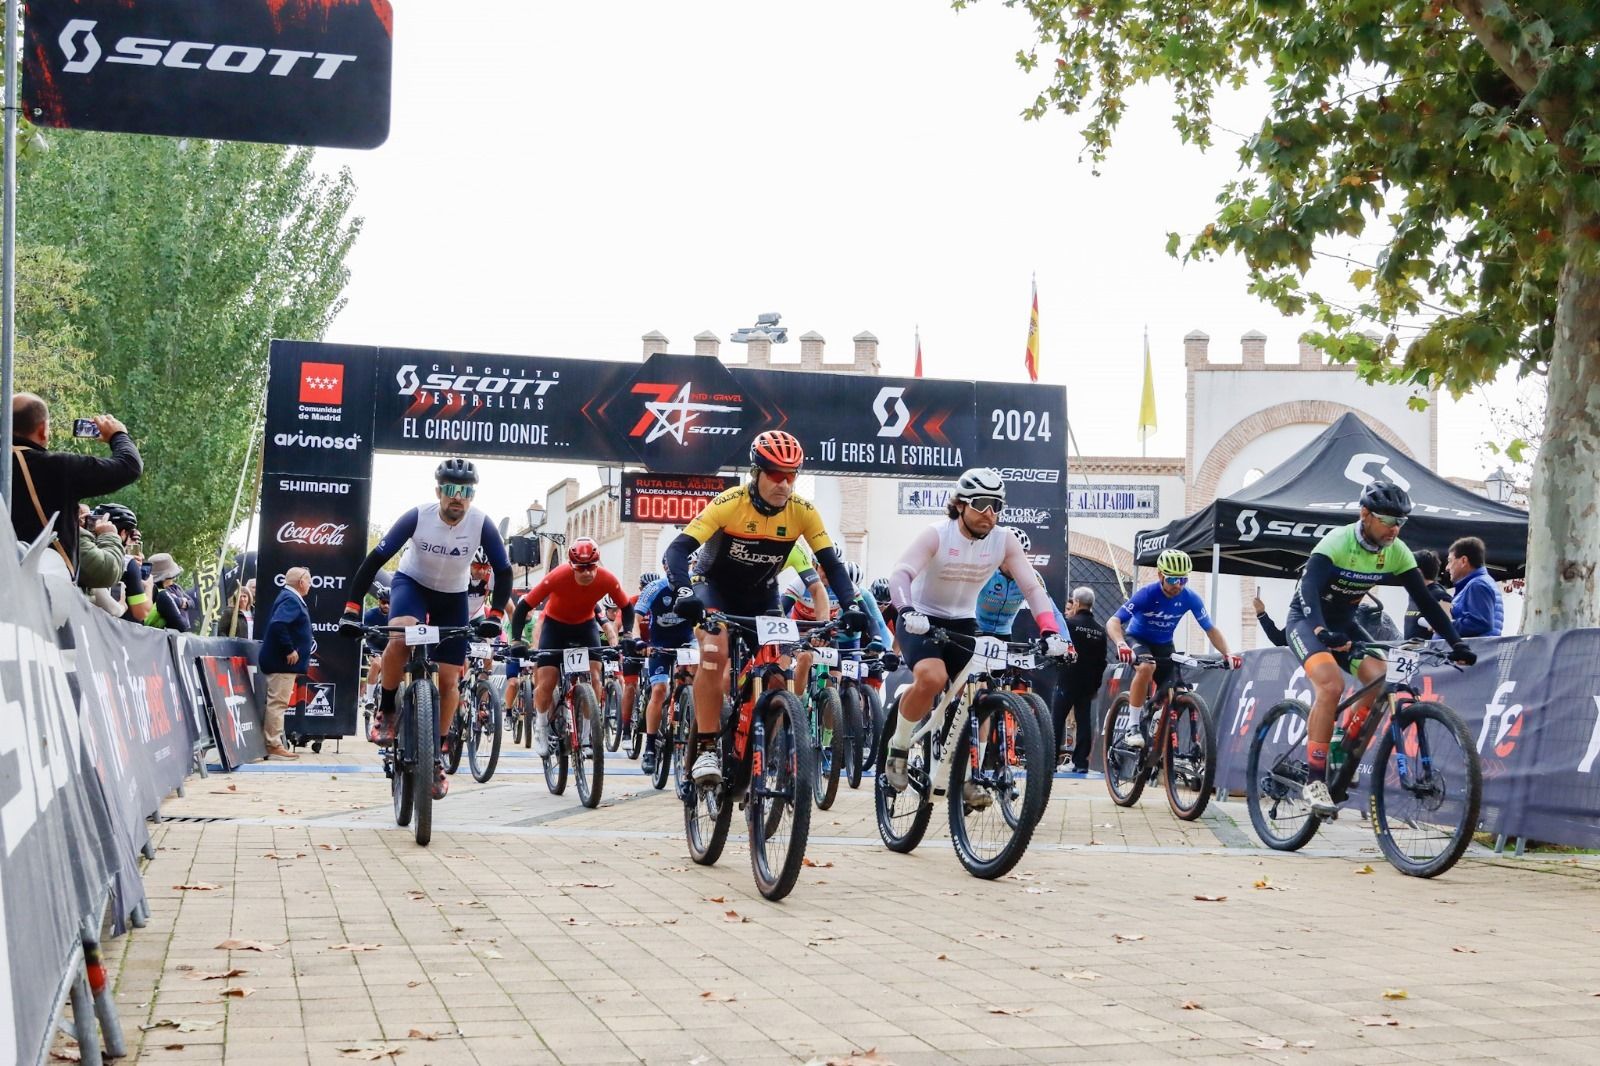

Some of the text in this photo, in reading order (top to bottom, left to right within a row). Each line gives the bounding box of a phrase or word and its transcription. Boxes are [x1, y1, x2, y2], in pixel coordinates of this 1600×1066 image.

[105, 36, 357, 80] SCOTT
[432, 364, 560, 379] CIRCUITO
[421, 374, 560, 396] SCOTT
[298, 405, 342, 414] Comunidad
[298, 412, 341, 421] de Madrid
[403, 417, 419, 438] EL
[425, 418, 493, 442] CIRCUITO
[500, 423, 549, 445] DONDE
[688, 426, 742, 435] SCOTT
[992, 409, 1051, 442] 2024
[274, 429, 358, 450] avimosa
[820, 438, 836, 461] TÚ
[841, 442, 875, 464] ERES
[880, 443, 896, 465] LA
[902, 445, 963, 468] ESTRELLA
[280, 480, 350, 494] SHIMANO
[636, 479, 664, 488] RUTA
[665, 480, 685, 489] DEL
[636, 487, 722, 497] VALDEOLMOS-ALALPARD
[922, 490, 952, 508] PLAZ
[1077, 492, 1135, 510] ALALPARDO
[998, 508, 1038, 518] CTORY
[276, 521, 349, 546] Coca-Cola
[730, 541, 749, 554] EL
[1142, 533, 1170, 550] SCOTT
[729, 550, 784, 566] CALDERO
[274, 573, 346, 589] GORT
[418, 626, 427, 635] 9
[766, 621, 789, 634] 28
[983, 641, 1000, 659] 10
[569, 652, 583, 665] 17
[1396, 656, 1412, 673] 24
[843, 663, 854, 672] 32
